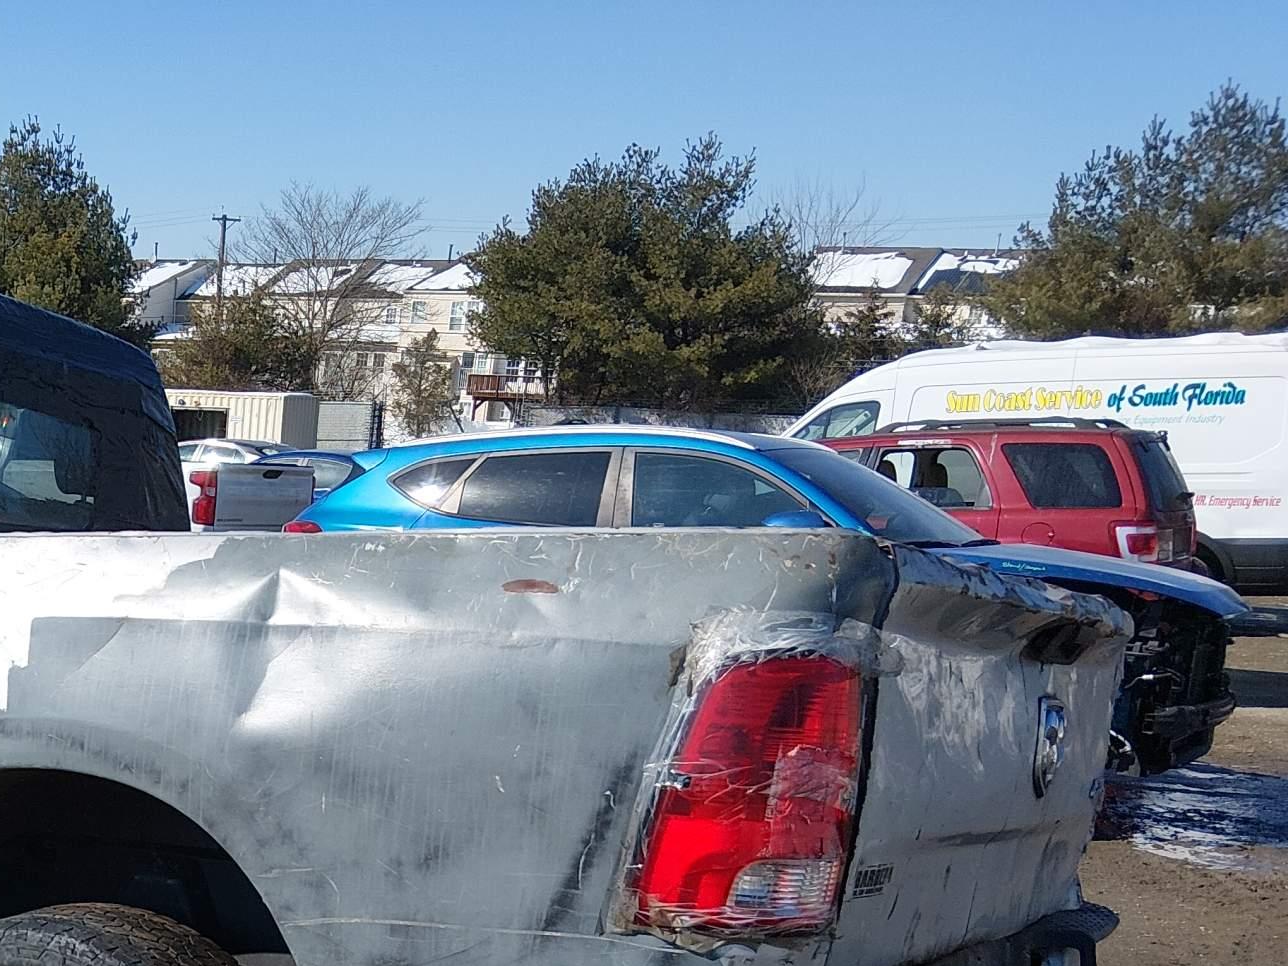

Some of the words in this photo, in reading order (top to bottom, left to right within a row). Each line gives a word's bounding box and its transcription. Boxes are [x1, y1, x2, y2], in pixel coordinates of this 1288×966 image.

[946, 390, 980, 413] Sun
[983, 387, 1033, 412] Coast
[1034, 385, 1103, 411] Service
[1107, 384, 1127, 413] of
[1128, 383, 1179, 407] South
[1182, 381, 1246, 412] Florida
[1208, 495, 1252, 509] Emergency
[1252, 496, 1282, 506] Service
